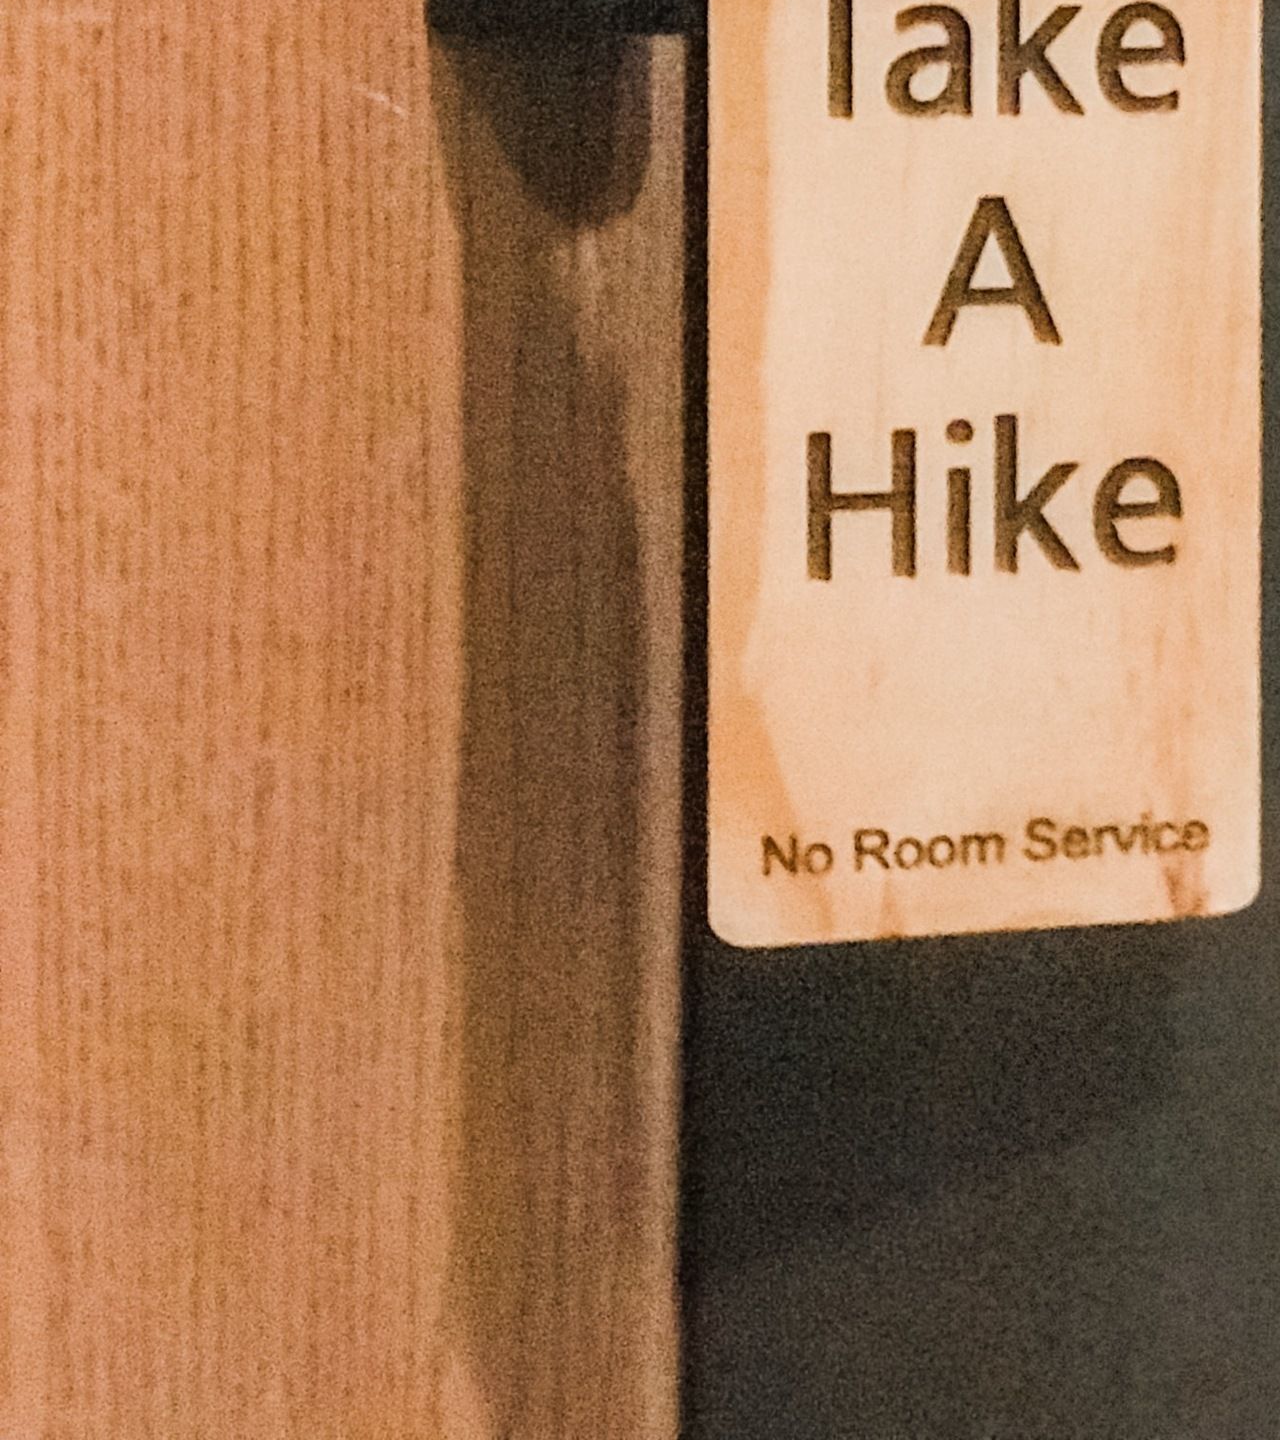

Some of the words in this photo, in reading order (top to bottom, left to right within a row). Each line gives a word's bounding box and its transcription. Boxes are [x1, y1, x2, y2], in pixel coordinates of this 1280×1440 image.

[921, 195, 1063, 346] A
[806, 413, 1182, 582] Hike
[761, 832, 834, 877] No
[853, 827, 1005, 871] Room
[1023, 813, 1211, 861] Service
